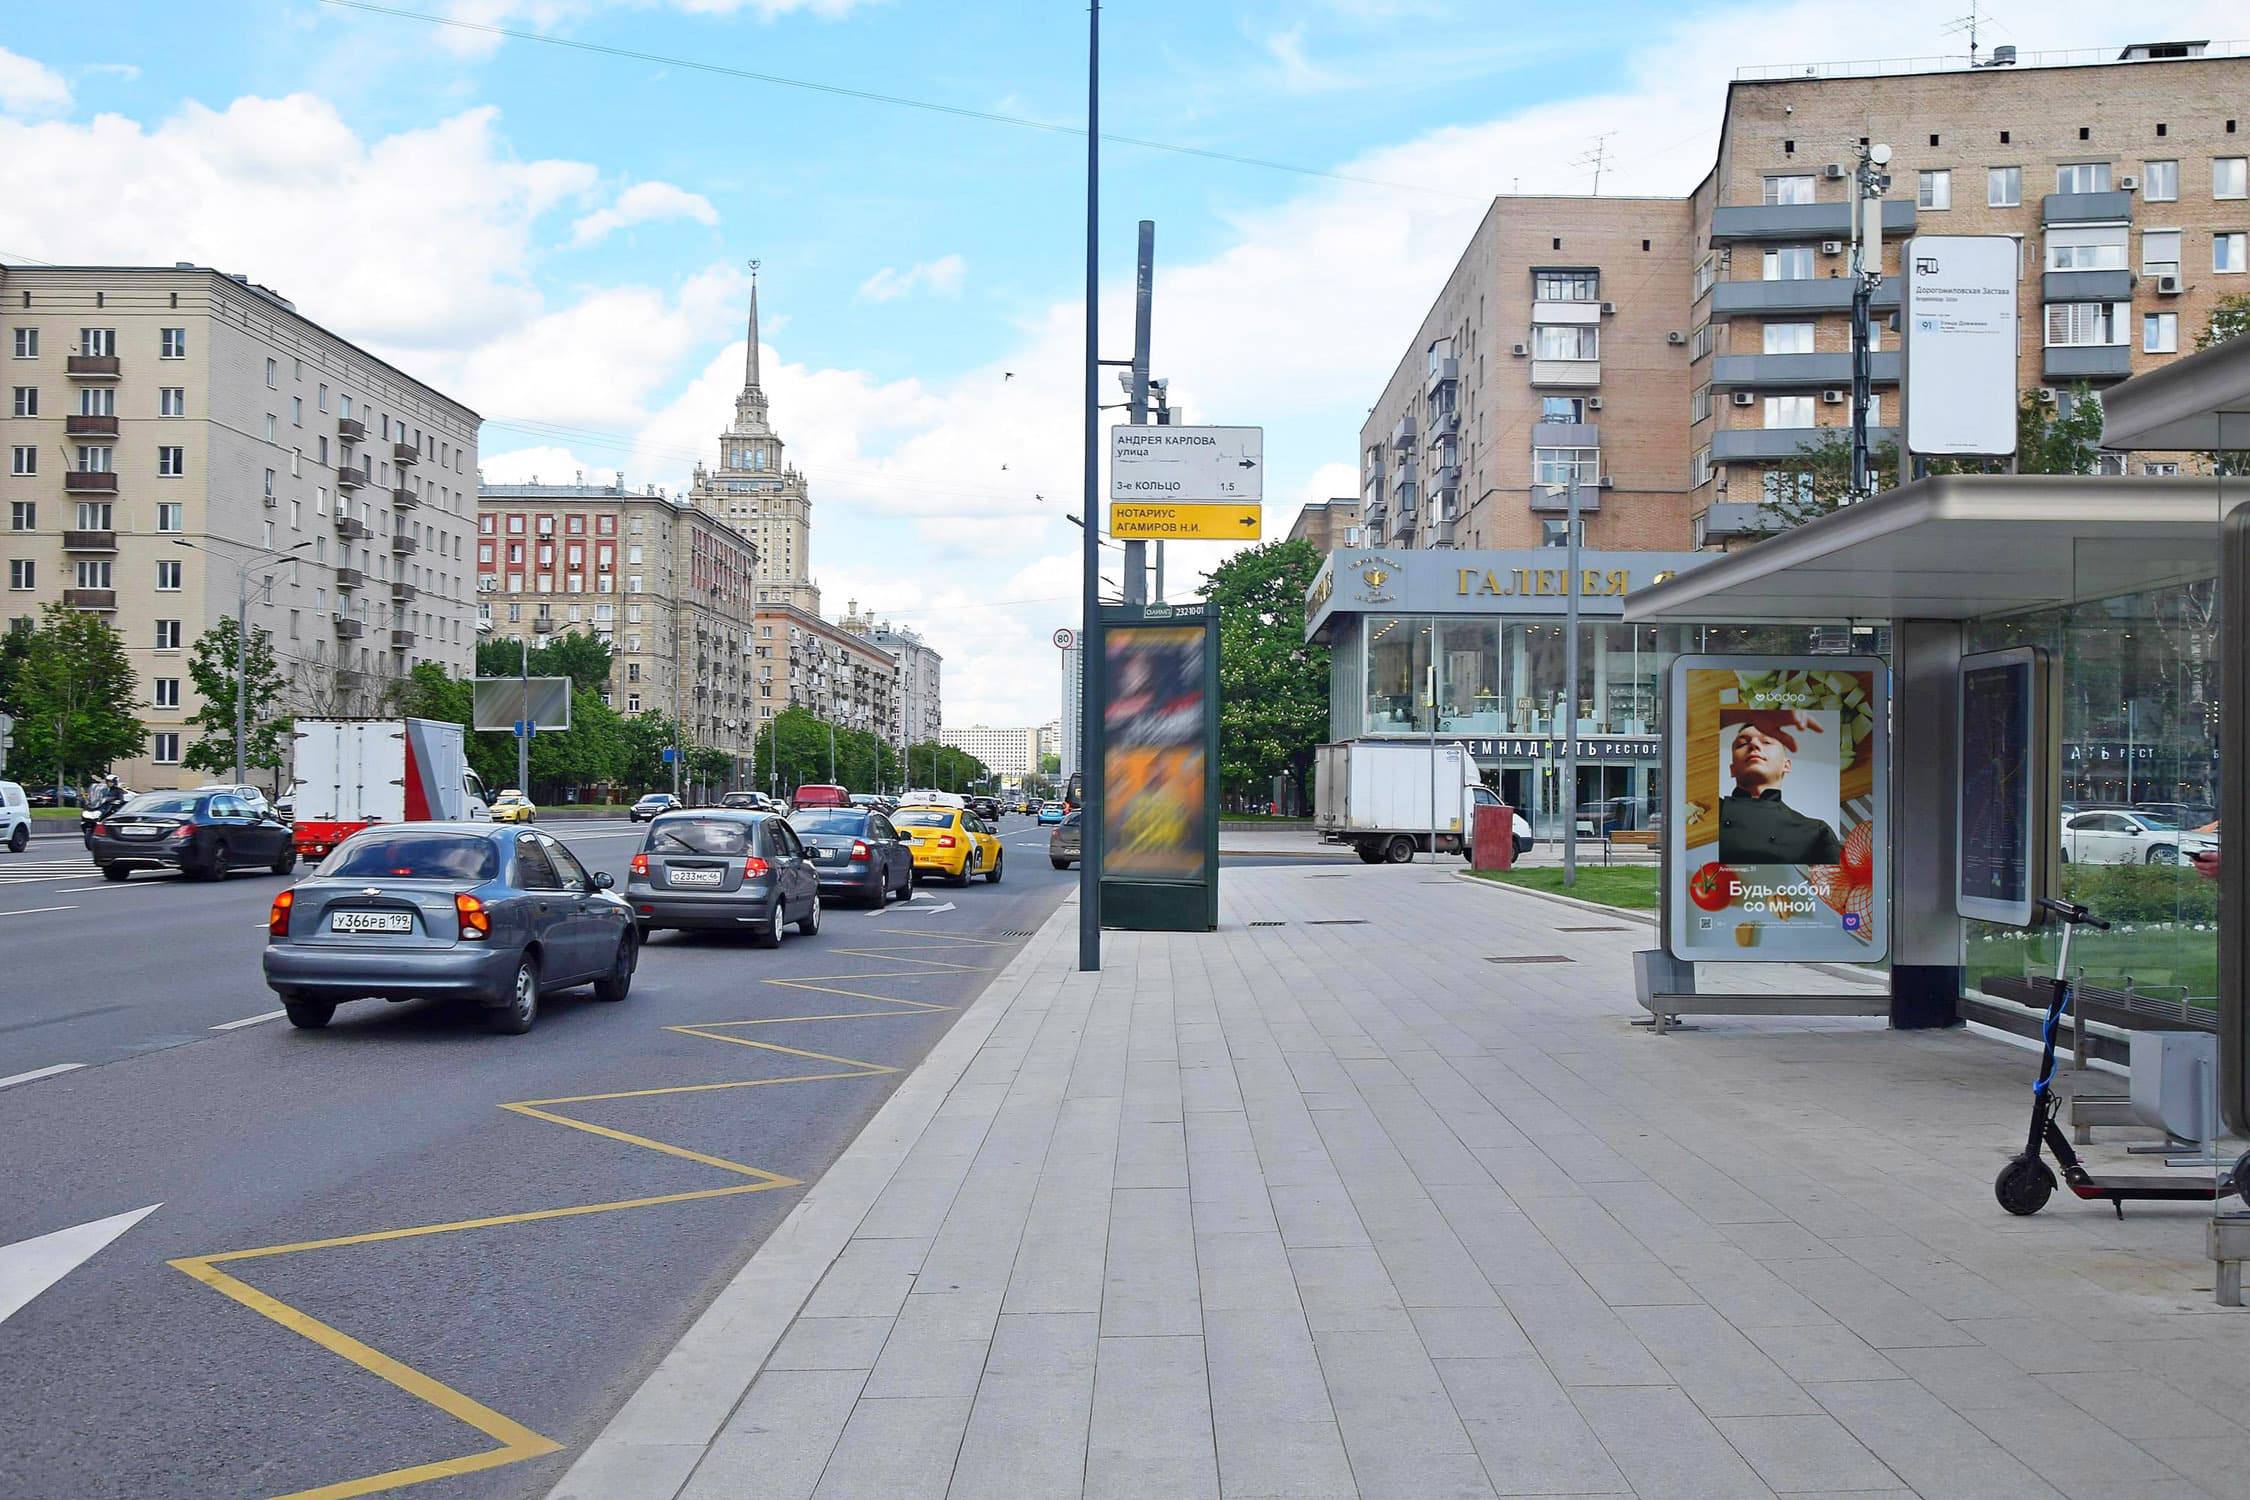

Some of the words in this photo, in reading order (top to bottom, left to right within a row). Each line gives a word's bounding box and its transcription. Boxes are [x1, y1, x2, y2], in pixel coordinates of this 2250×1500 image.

[1982, 287, 2010, 295] Застава
[1922, 321, 1932, 329] 91
[1117, 436, 1162, 445] АНДРЕЯ
[1165, 436, 1216, 446] КАРЛОВА
[1117, 449, 1149, 457] улица
[1117, 481, 1132, 490] 3-е
[1136, 481, 1181, 491] КОЛЬЦО
[1221, 482, 1235, 491] 1.5
[1117, 509, 1176, 518] НОТАРИУС
[1117, 523, 1177, 532] АГАМИРОВ
[1180, 524, 1201, 532] Н.И.
[1146, 608, 1171, 616] ОЛИМП
[1766, 691, 1805, 701] badoo
[1729, 881, 1772, 900] Будь
[1776, 880, 1830, 897] собой
[1743, 900, 1765, 912] со
[1769, 897, 1816, 912] мной
[389, 915, 408, 926] 199
